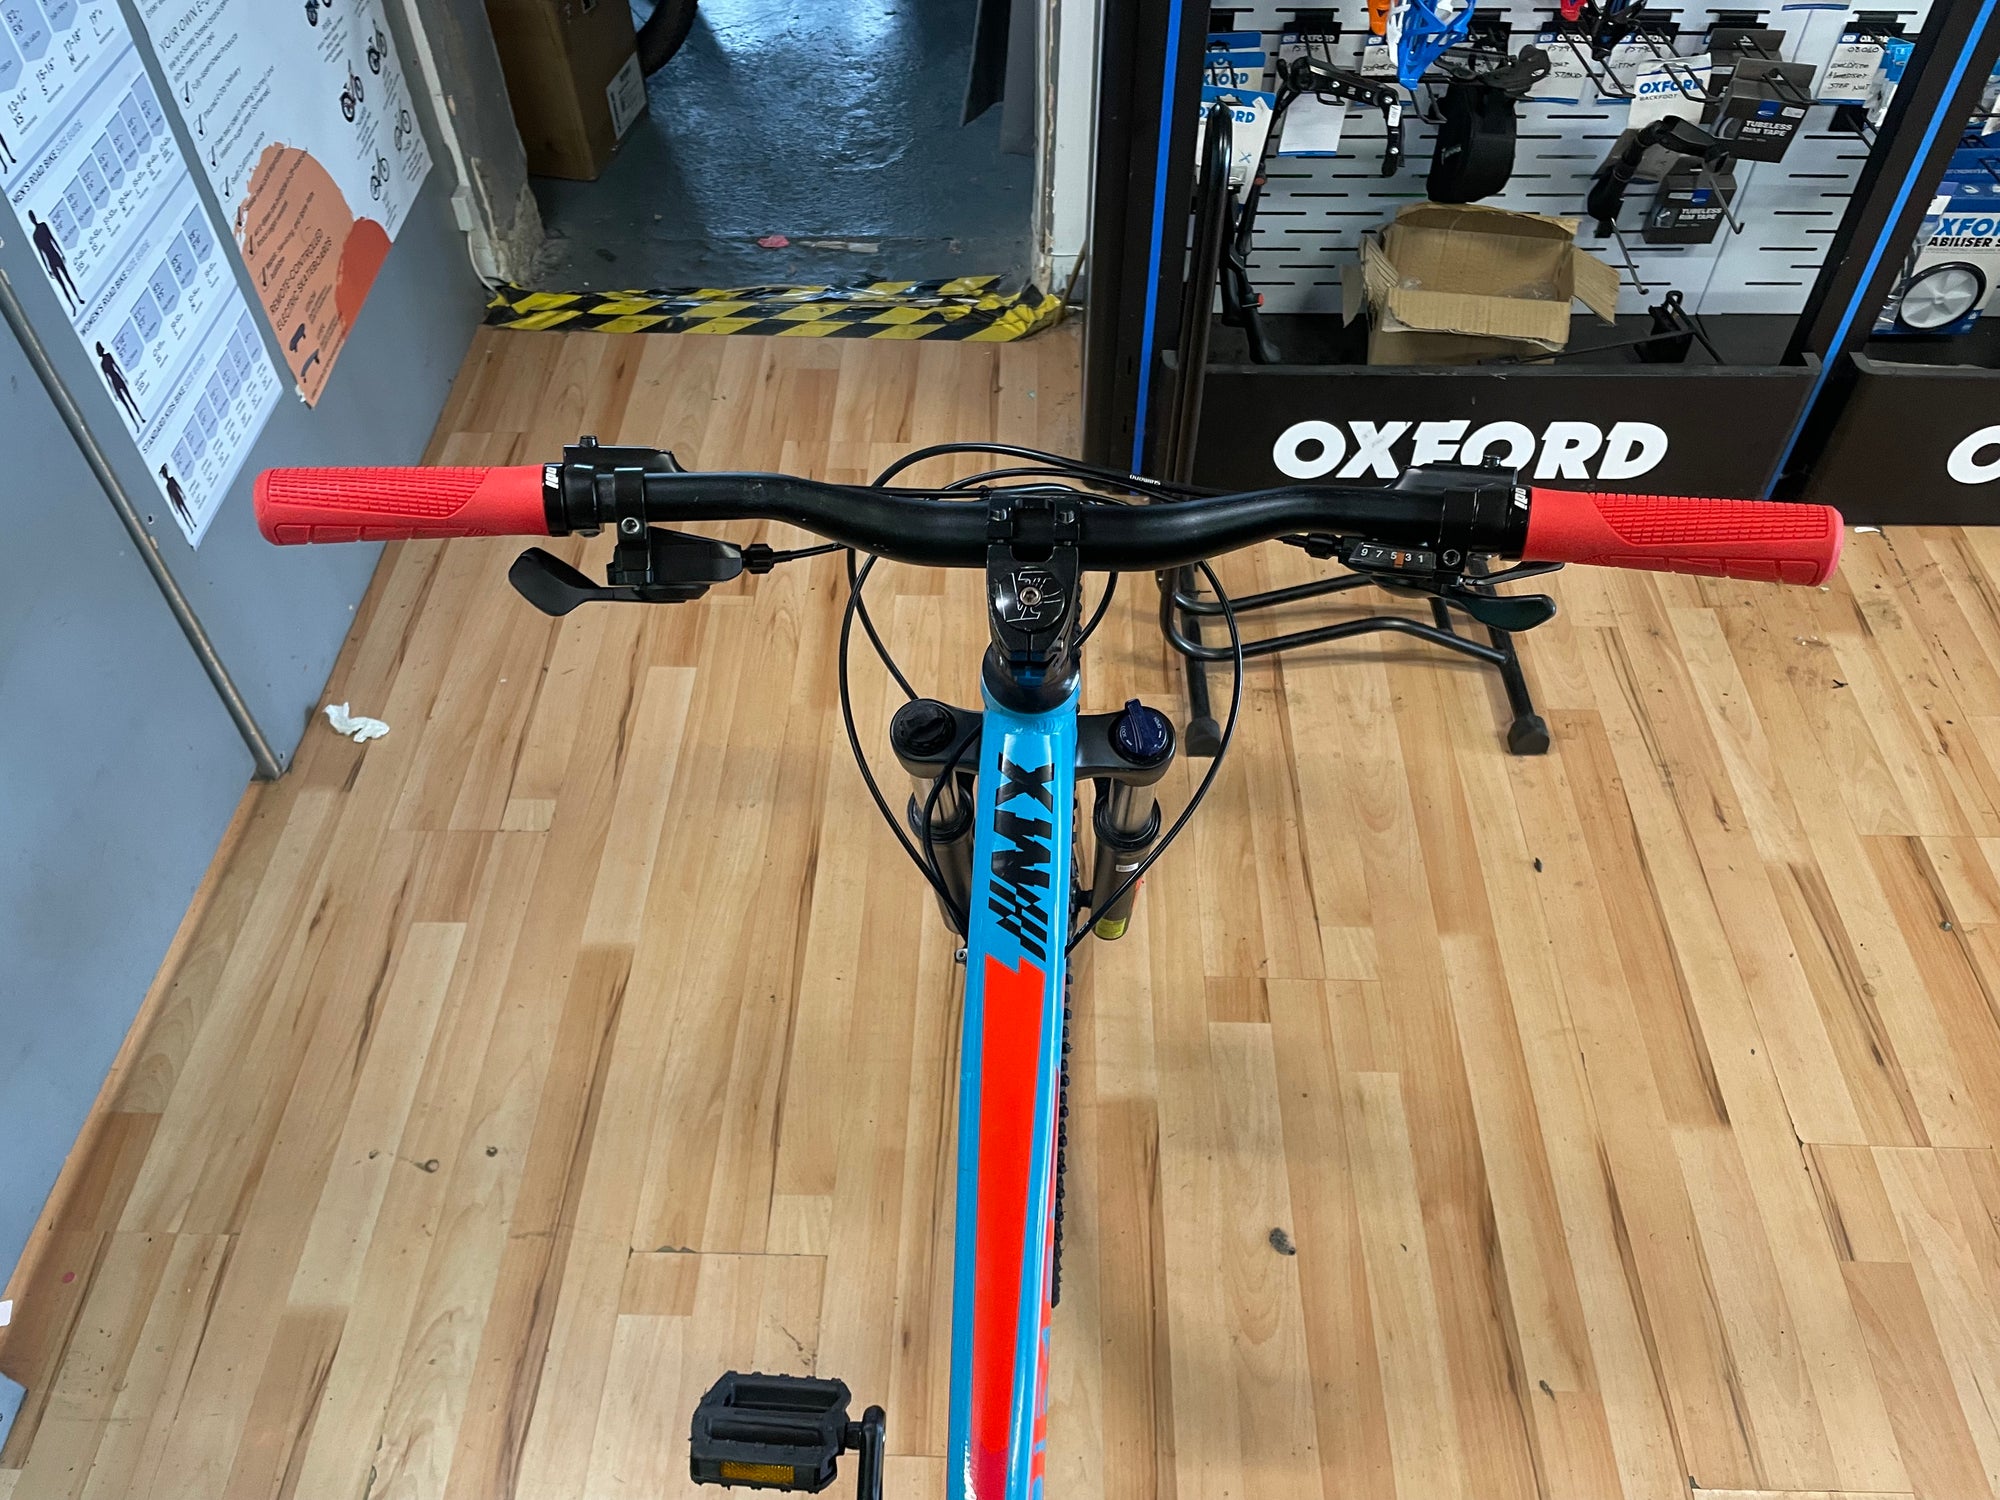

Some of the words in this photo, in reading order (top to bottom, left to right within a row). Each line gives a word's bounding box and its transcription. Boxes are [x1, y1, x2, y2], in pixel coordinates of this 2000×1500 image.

[159, 26, 179, 53] YOUR
[178, 7, 198, 31] OWN
[1742, 126, 1761, 134] RIM
[1763, 128, 1788, 136] TAPE
[1746, 120, 1793, 131] TUBELESS
[270, 228, 324, 316] REMOTE-CONTROLLED
[1272, 420, 1669, 480] OXFORD
[1360, 548, 1368, 556] 9
[1376, 550, 1384, 558] 7
[1390, 551, 1398, 560] 5
[1404, 553, 1412, 562] 3
[1418, 554, 1424, 563] 1
